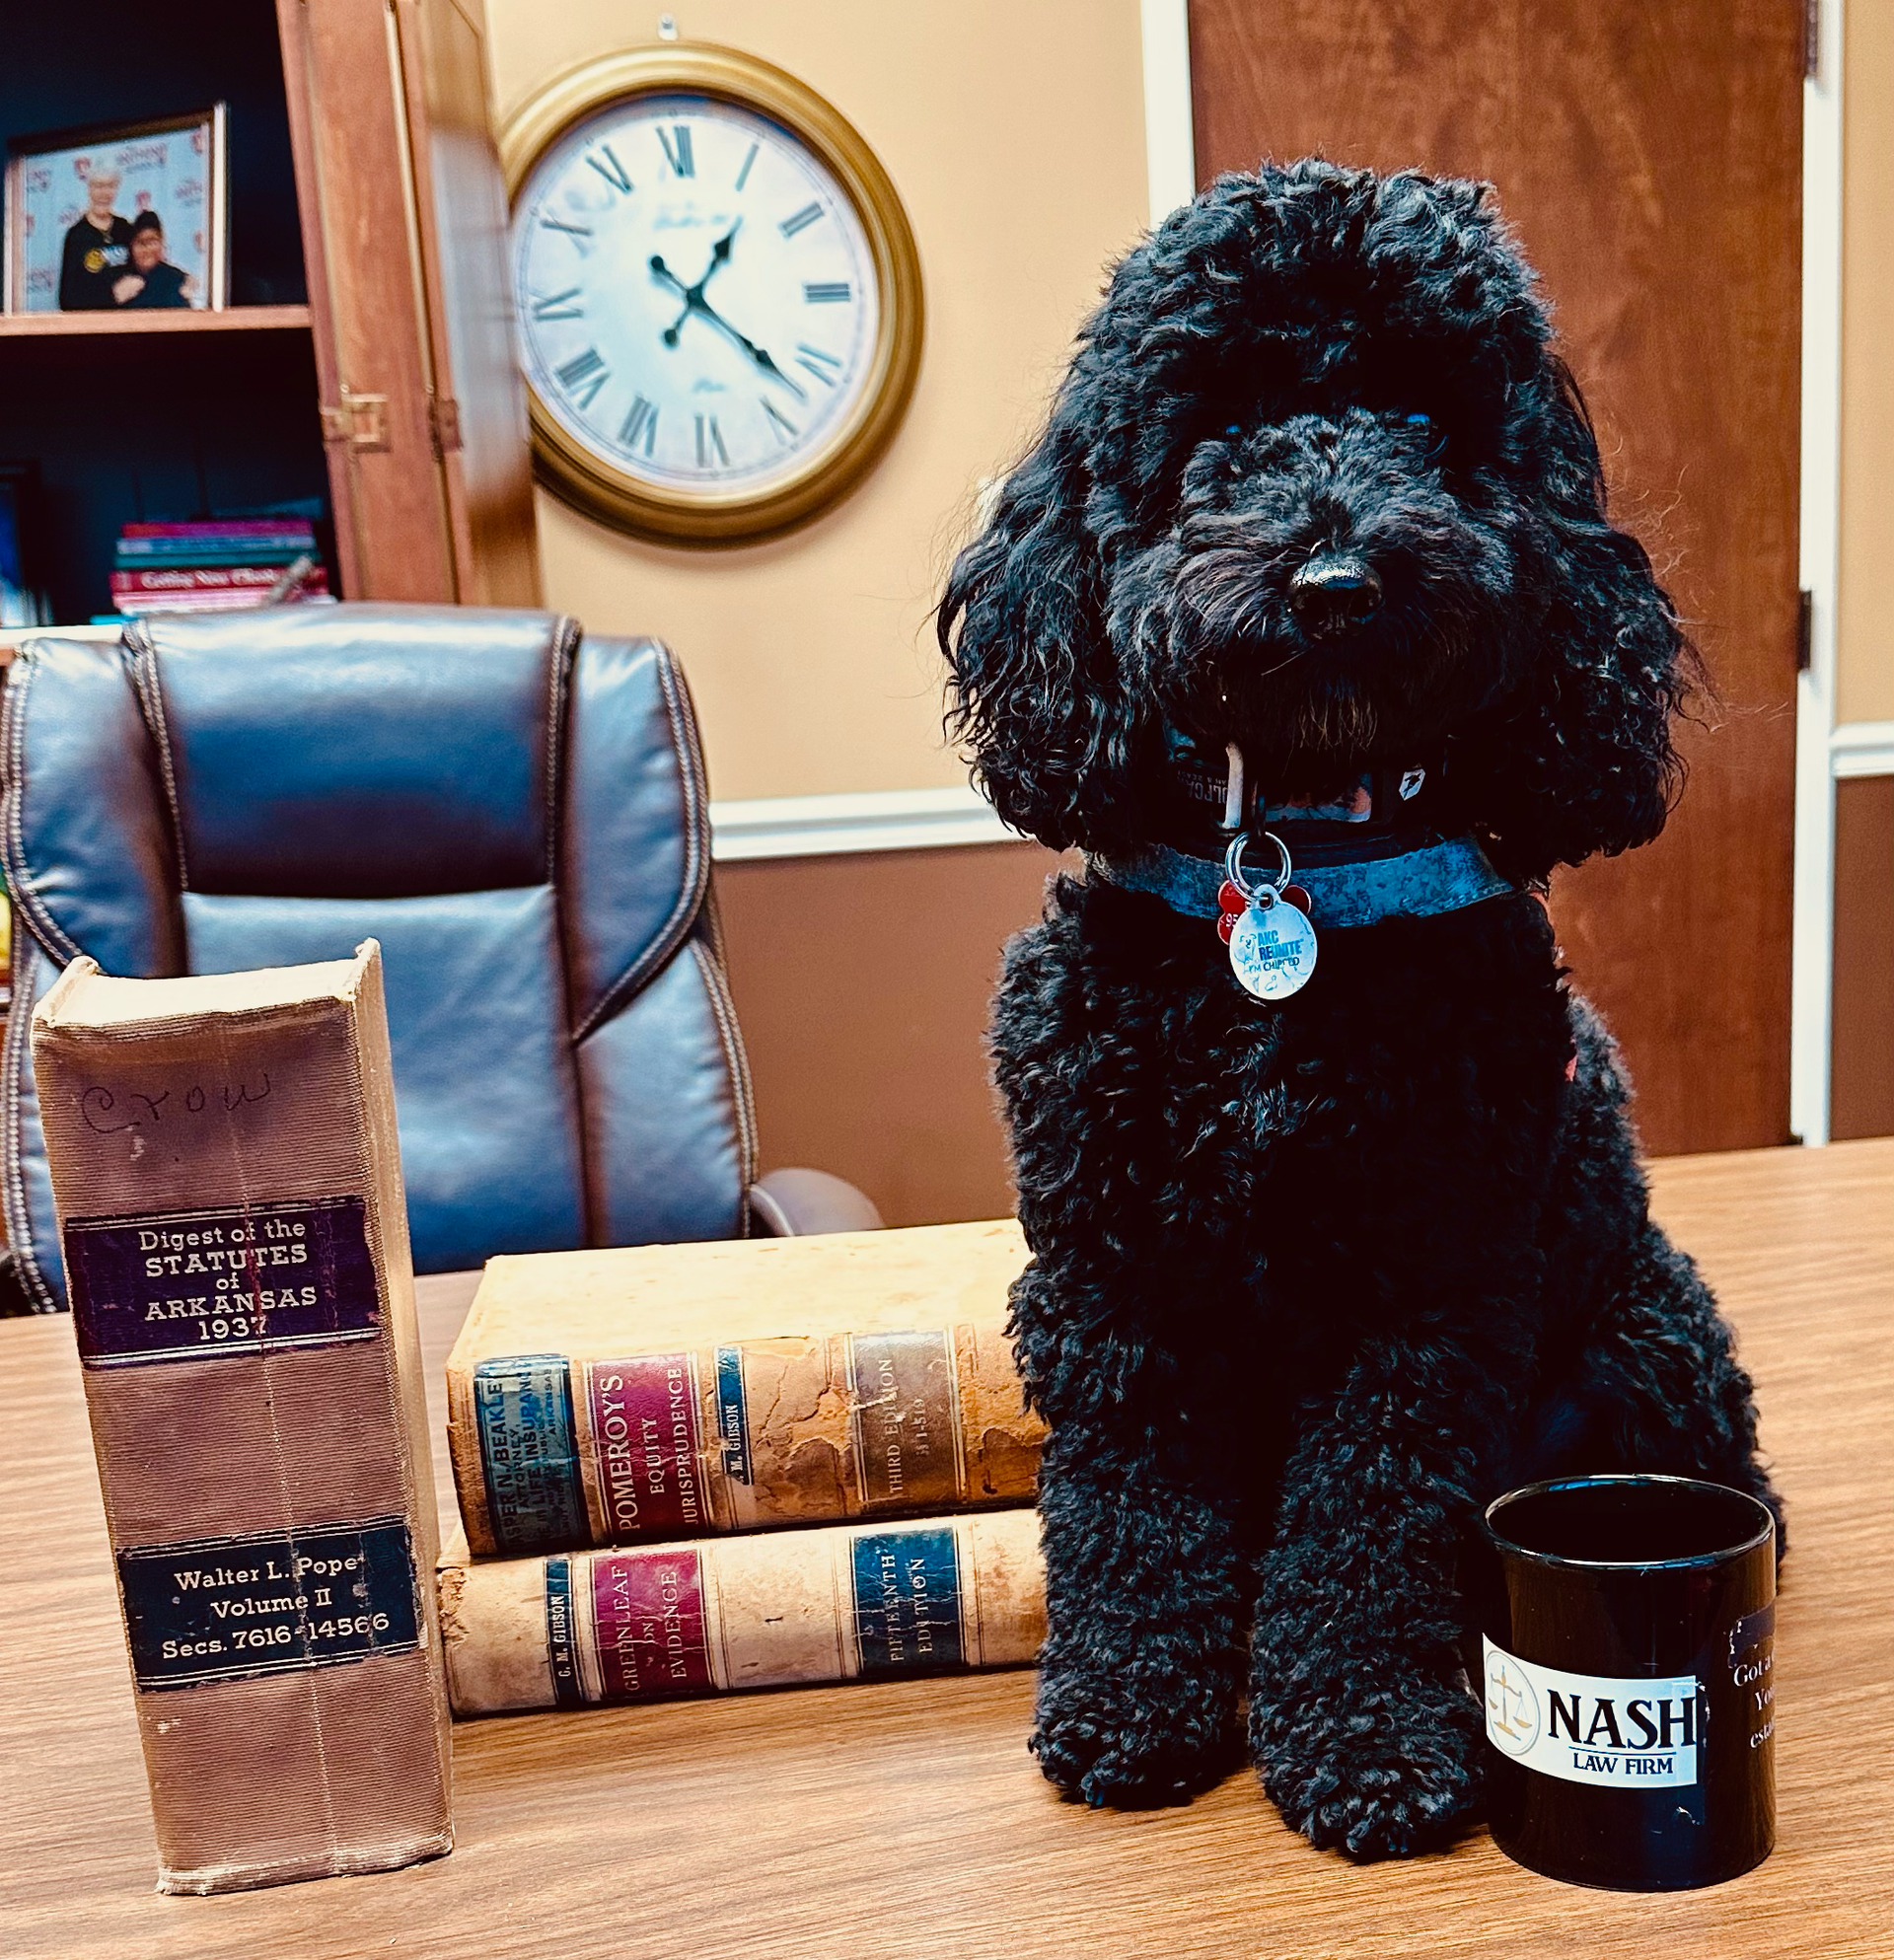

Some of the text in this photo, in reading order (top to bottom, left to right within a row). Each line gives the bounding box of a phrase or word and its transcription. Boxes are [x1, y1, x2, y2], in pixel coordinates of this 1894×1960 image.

[805, 283, 850, 303] III
[1257, 930, 1278, 947] AKC
[138, 1219, 306, 1252] Digest of the
[145, 1244, 308, 1277] STATUTES
[216, 1271, 241, 1290] of
[144, 1286, 318, 1321] ARKANSAS
[198, 1315, 267, 1341] 1937
[487, 1380, 510, 1462] BEAKLE
[725, 1404, 742, 1451] GIBSON
[600, 1375, 640, 1532] POMEROY'S
[641, 1417, 665, 1495] EQUITY
[668, 1368, 698, 1525] JURISPRUDENCE
[528, 1466, 546, 1505] LIFE
[887, 1444, 904, 1493] THIRD
[499, 1492, 524, 1545] ASPER
[175, 1557, 358, 1591] Walter L. Pope
[210, 1588, 332, 1619] Volume II
[551, 1595, 566, 1643] GIBSON
[661, 1571, 687, 1678] EVIDENCE
[881, 1555, 905, 1662] FIFTEENTH
[911, 1559, 933, 1653] EDITION
[162, 1612, 390, 1660] Secs. 7616-14566
[612, 1565, 640, 1691] GREENLEAF
[642, 1622, 656, 1642] ON
[556, 1647, 571, 1662] M.
[1733, 1660, 1763, 1687] Got
[1547, 1689, 1697, 1750] NASH
[1573, 1753, 1674, 1775] LAW FIRM
